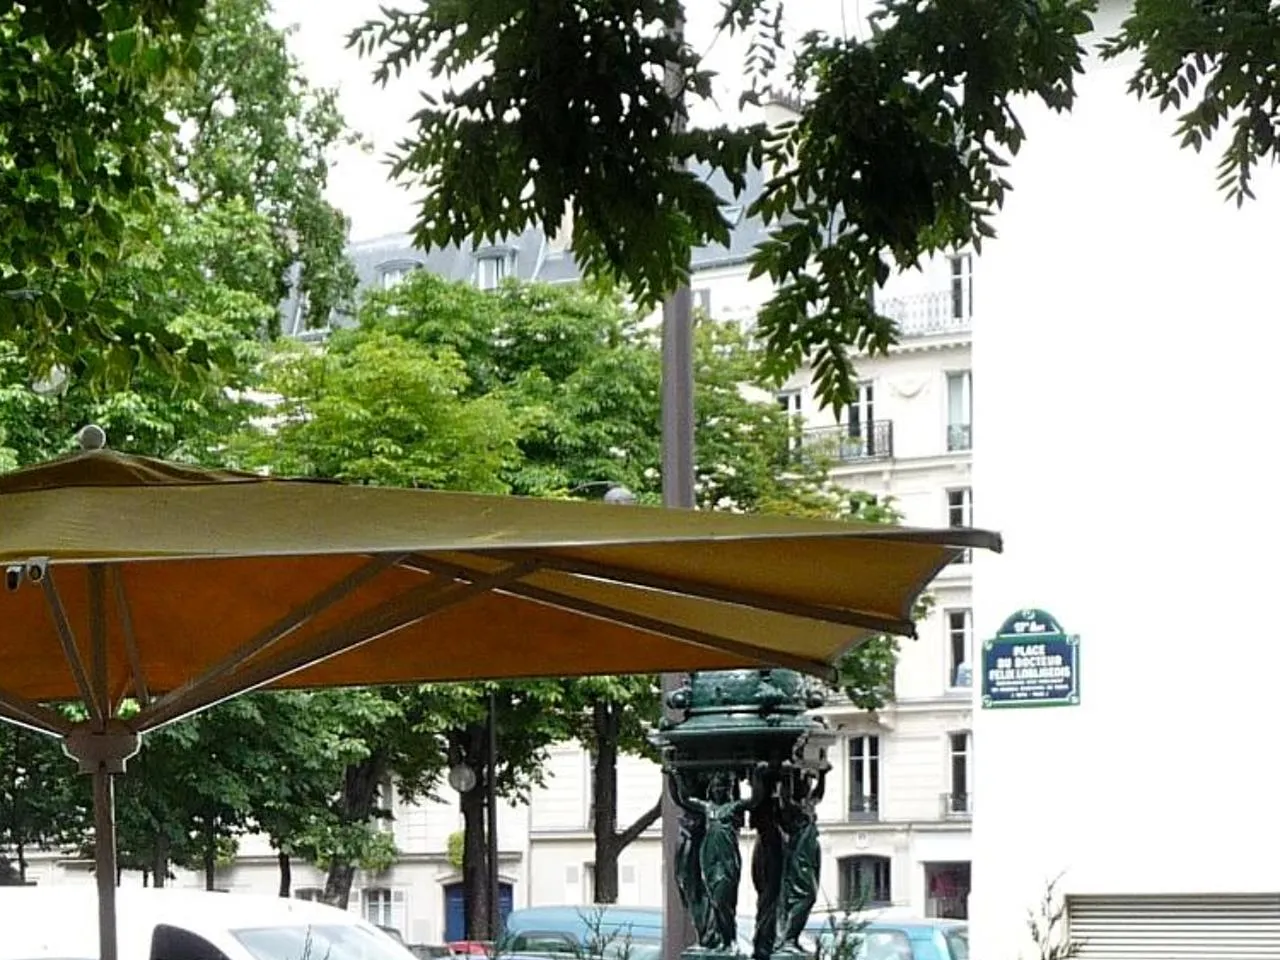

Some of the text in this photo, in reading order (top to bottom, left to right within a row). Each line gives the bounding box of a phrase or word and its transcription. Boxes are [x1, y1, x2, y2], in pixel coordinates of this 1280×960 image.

[1013, 644, 1046, 656] PLACE
[997, 655, 1062, 668] DU DOCTEUR
